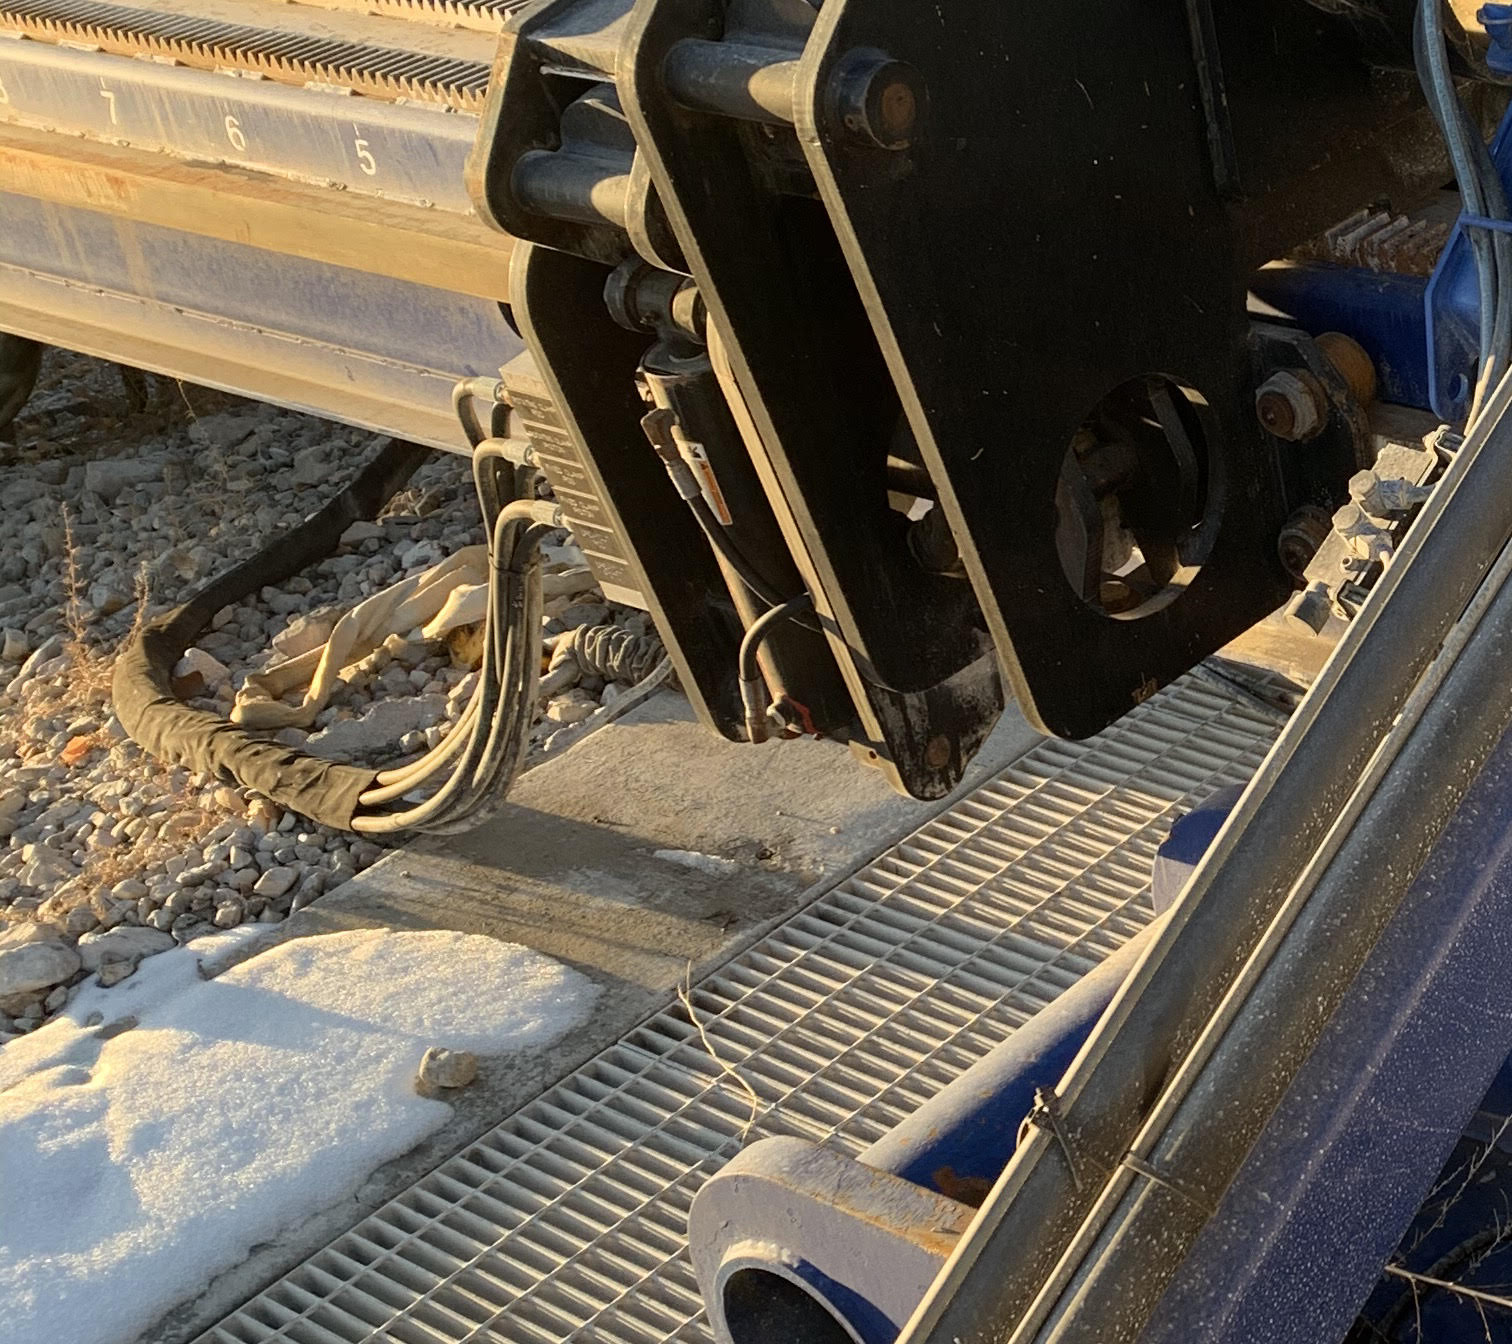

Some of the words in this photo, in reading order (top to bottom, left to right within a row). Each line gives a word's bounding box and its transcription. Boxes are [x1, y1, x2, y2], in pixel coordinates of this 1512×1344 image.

[101, 90, 117, 124] 7
[225, 115, 246, 151] 6
[355, 139, 376, 175] 5
